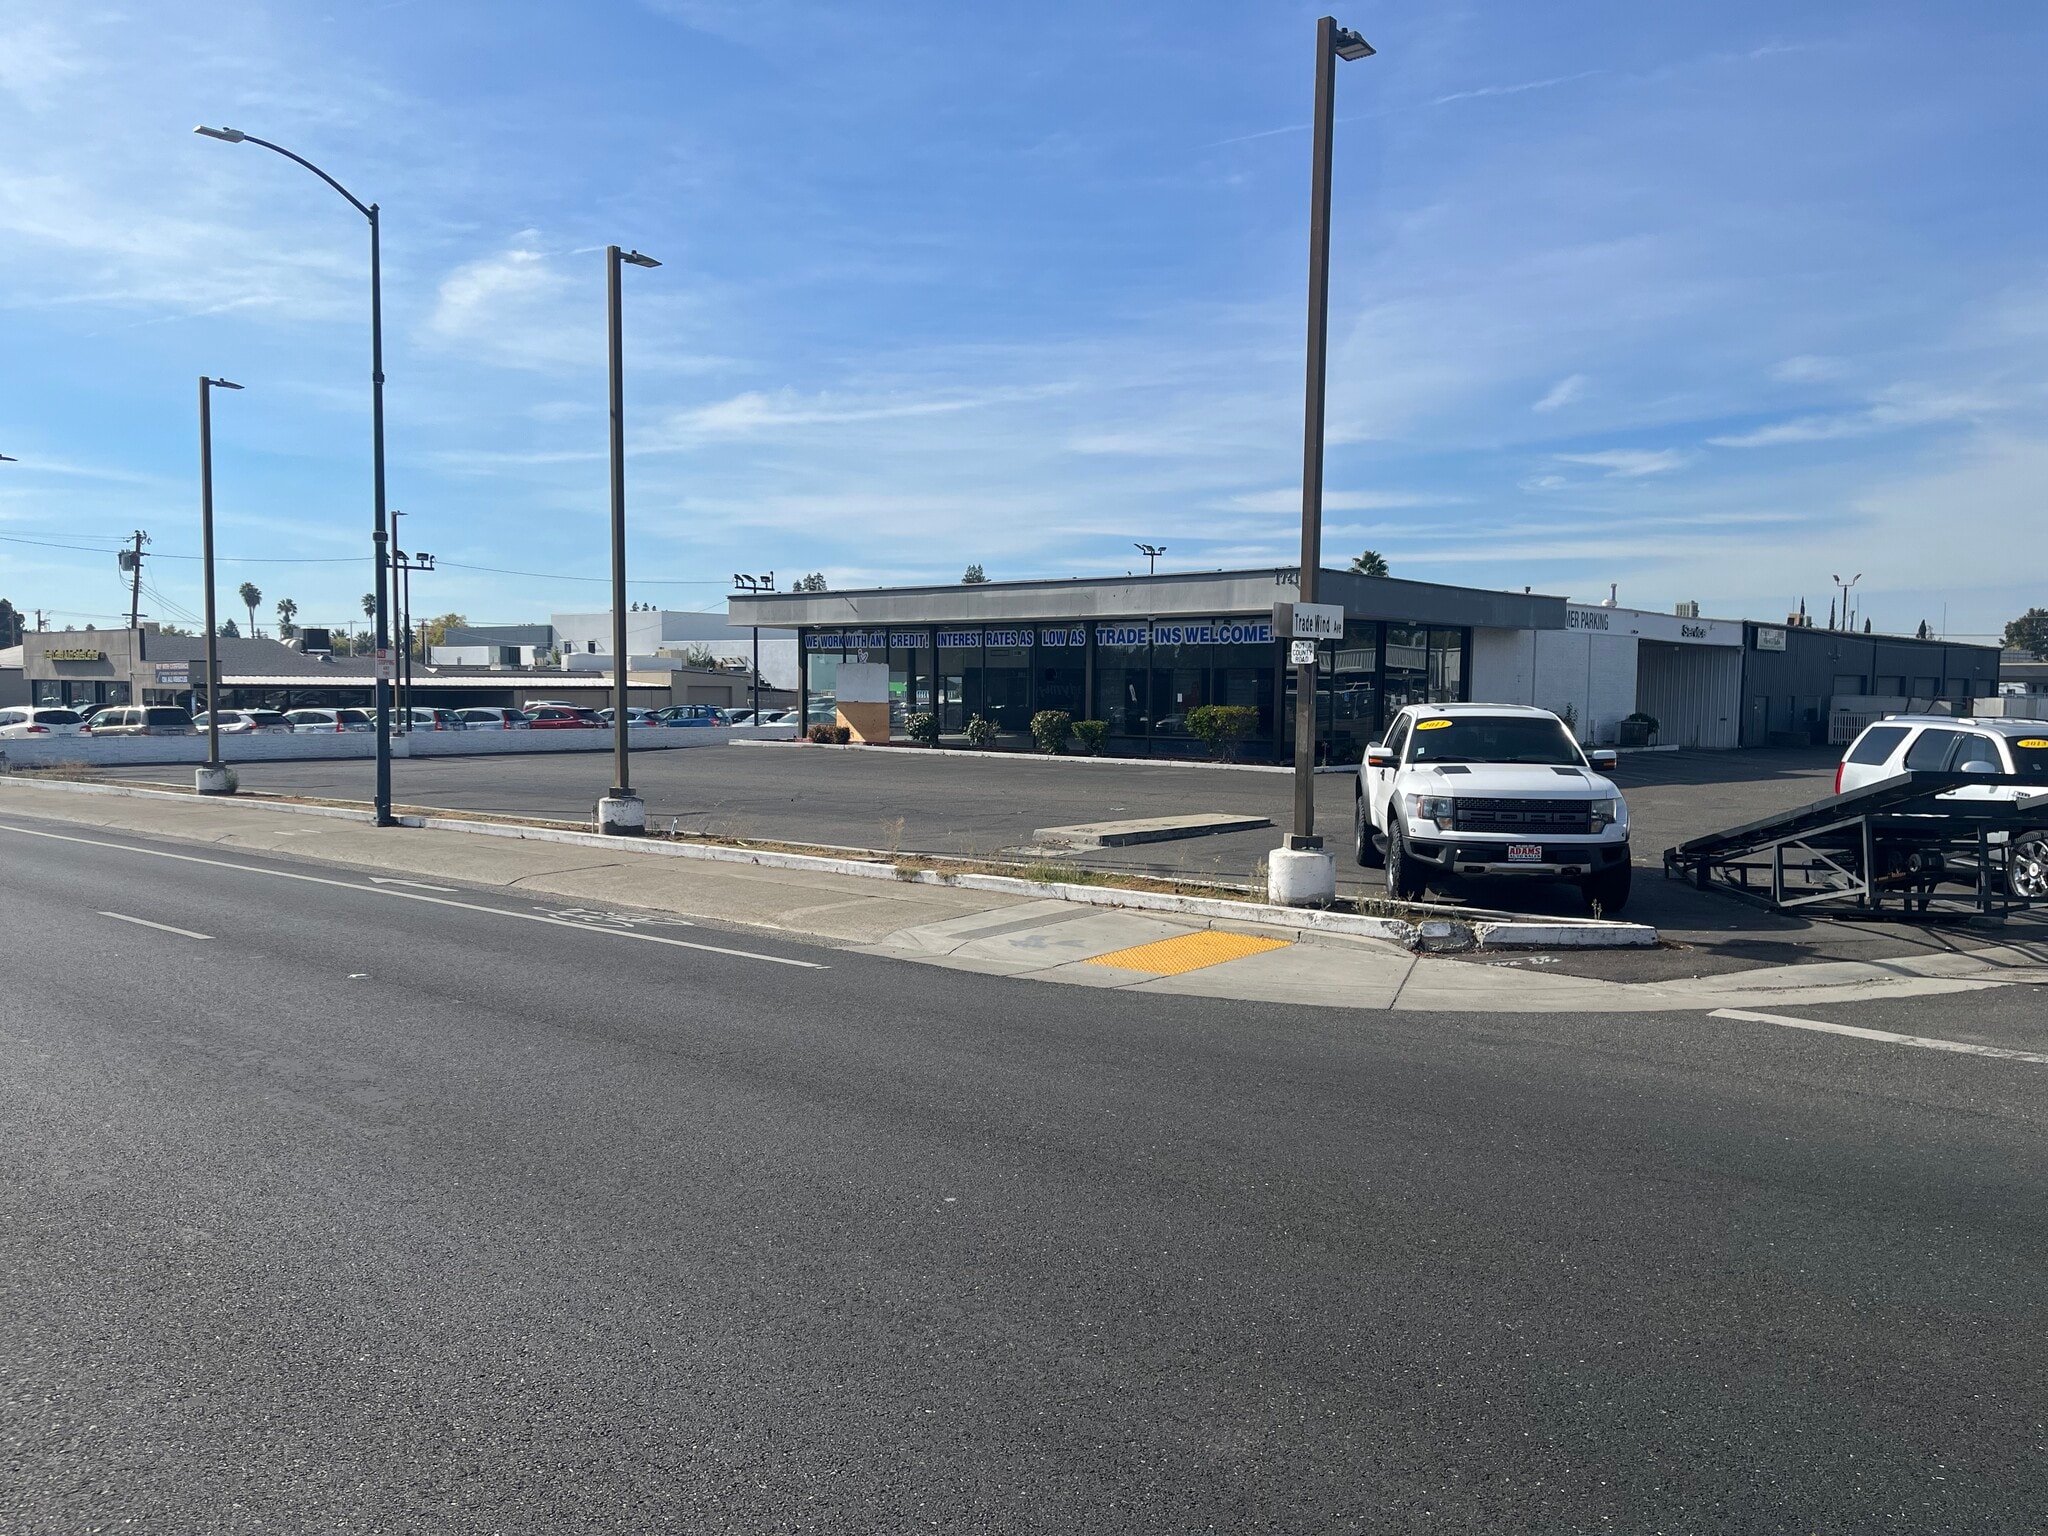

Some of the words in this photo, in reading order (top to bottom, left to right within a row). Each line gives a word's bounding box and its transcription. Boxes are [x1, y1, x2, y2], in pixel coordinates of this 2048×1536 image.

[1295, 613, 1313, 632] Trade
[1314, 614, 1330, 633] Wind
[1333, 620, 1342, 634] Ave
[1581, 611, 1609, 630] PARKING
[936, 631, 982, 647] INTEREST
[985, 631, 1017, 647] RATES
[1019, 630, 1034, 647] AS
[1042, 629, 1067, 646] LOW
[1069, 629, 1086, 646] AS
[1184, 624, 1275, 644] WELCOME!
[1681, 624, 1706, 638] Service
[805, 635, 818, 648] WE
[820, 634, 844, 648] WORK
[845, 633, 868, 648] WITH
[869, 633, 886, 648] ANY
[890, 633, 929, 648] CREDIT!
[1457, 809, 1588, 822] FORD
[1510, 847, 1541, 855] ADAMS
